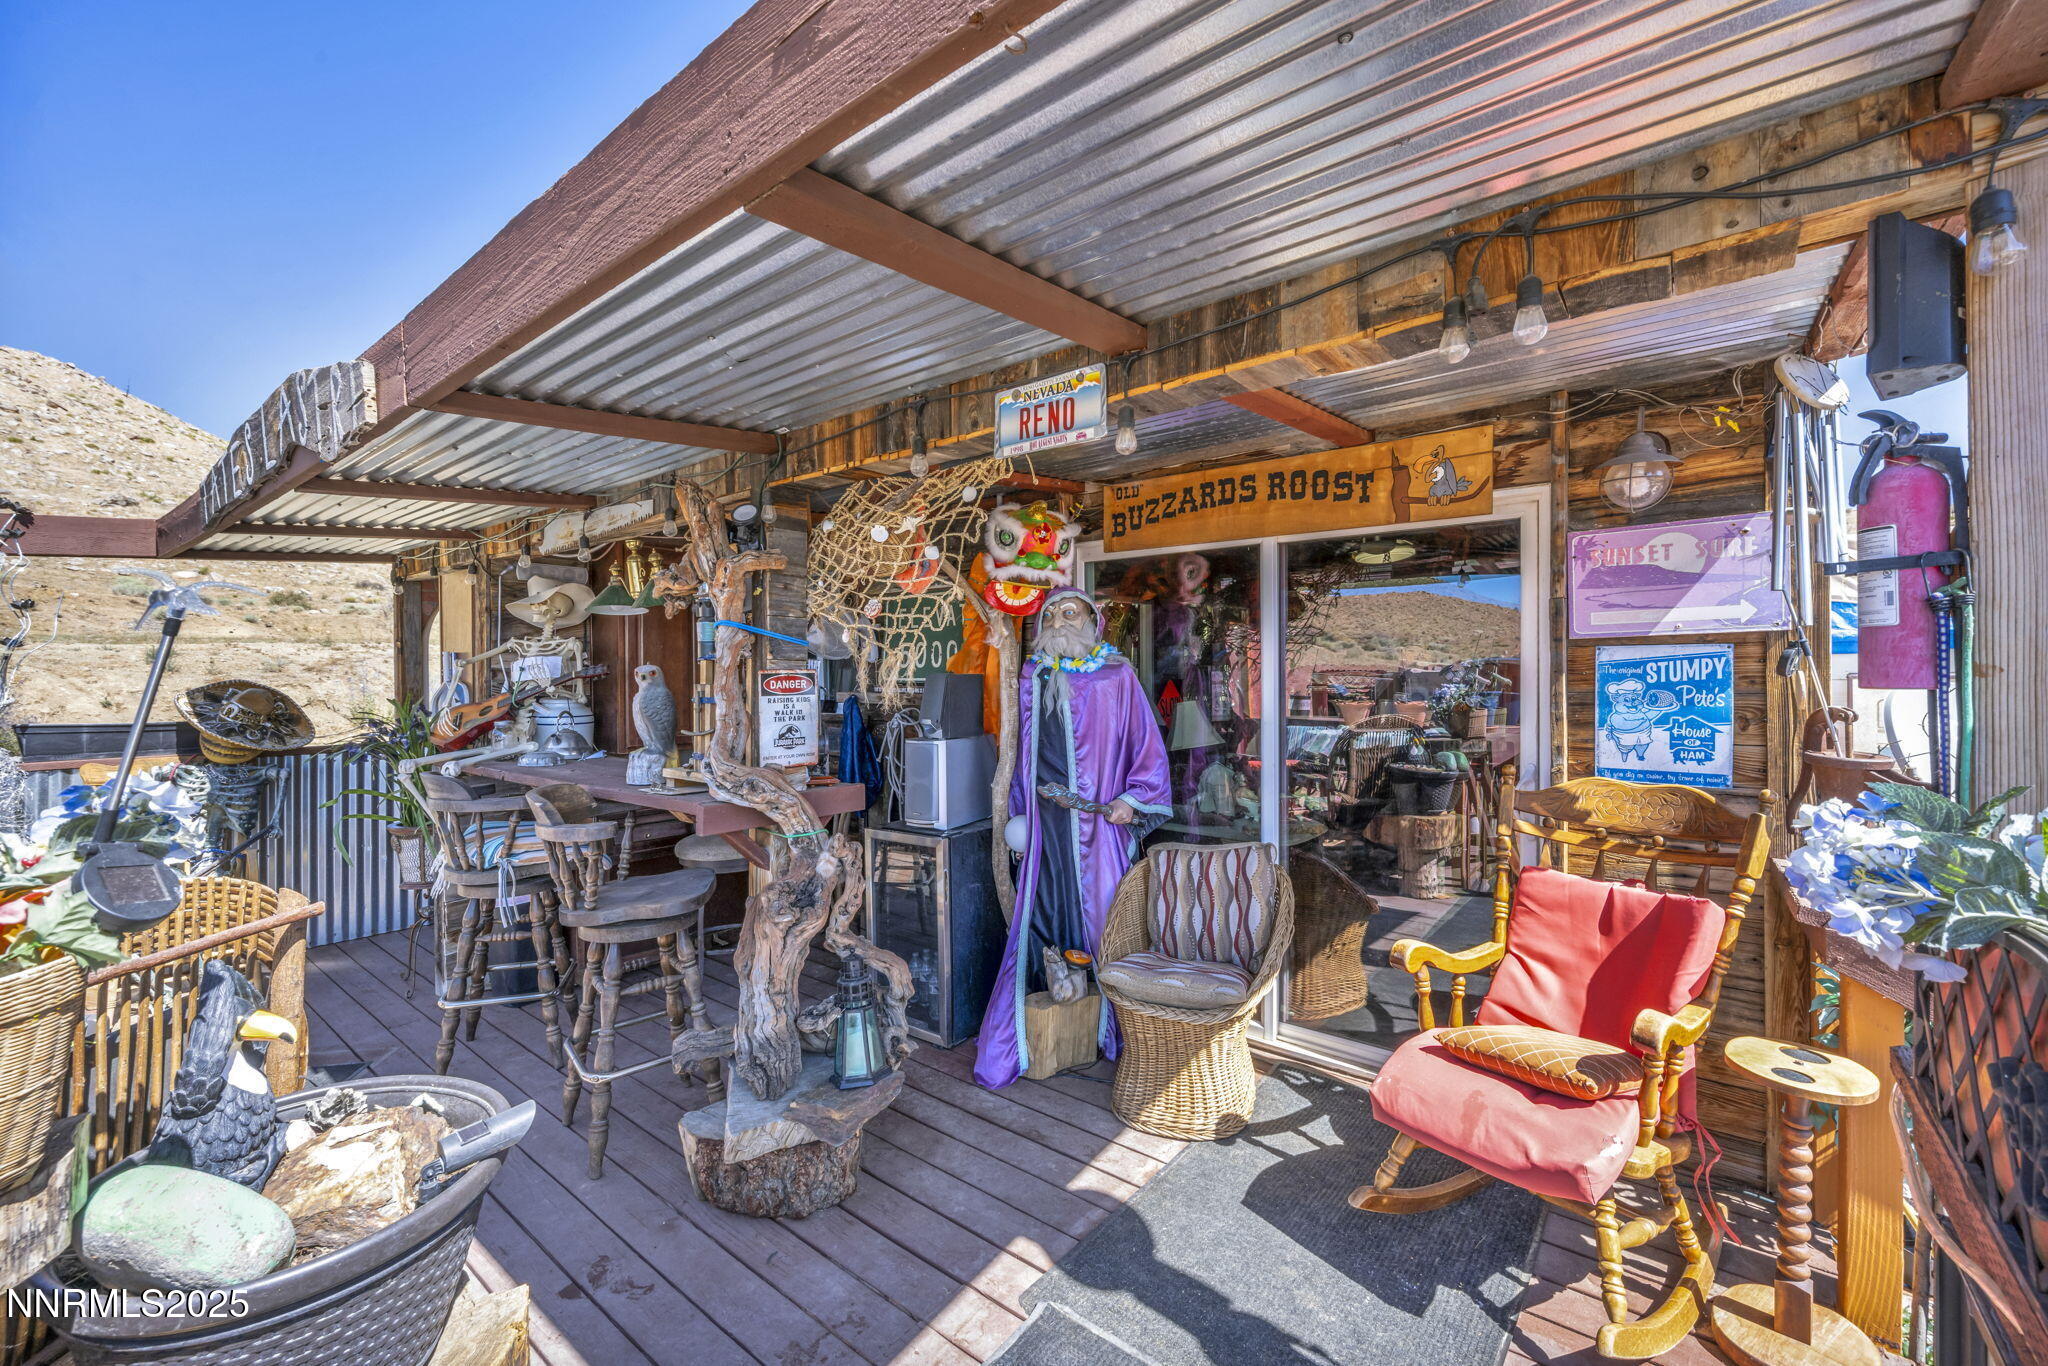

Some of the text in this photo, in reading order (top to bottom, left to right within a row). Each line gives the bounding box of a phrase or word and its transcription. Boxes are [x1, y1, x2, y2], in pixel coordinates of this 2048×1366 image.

[1023, 379, 1074, 402] NEVADA
[1019, 397, 1075, 440] RENO
[1111, 470, 1375, 537] BUZZARDS ROOST
[1590, 535, 1758, 568] SUNSET SURF
[1603, 656, 1727, 684] The original STUMPY
[769, 680, 807, 689] DANGER
[1675, 685, 1726, 707] Pete's
[1672, 722, 1711, 738] House
[1681, 750, 1705, 760] HAM
[1625, 771, 1635, 781] dig
